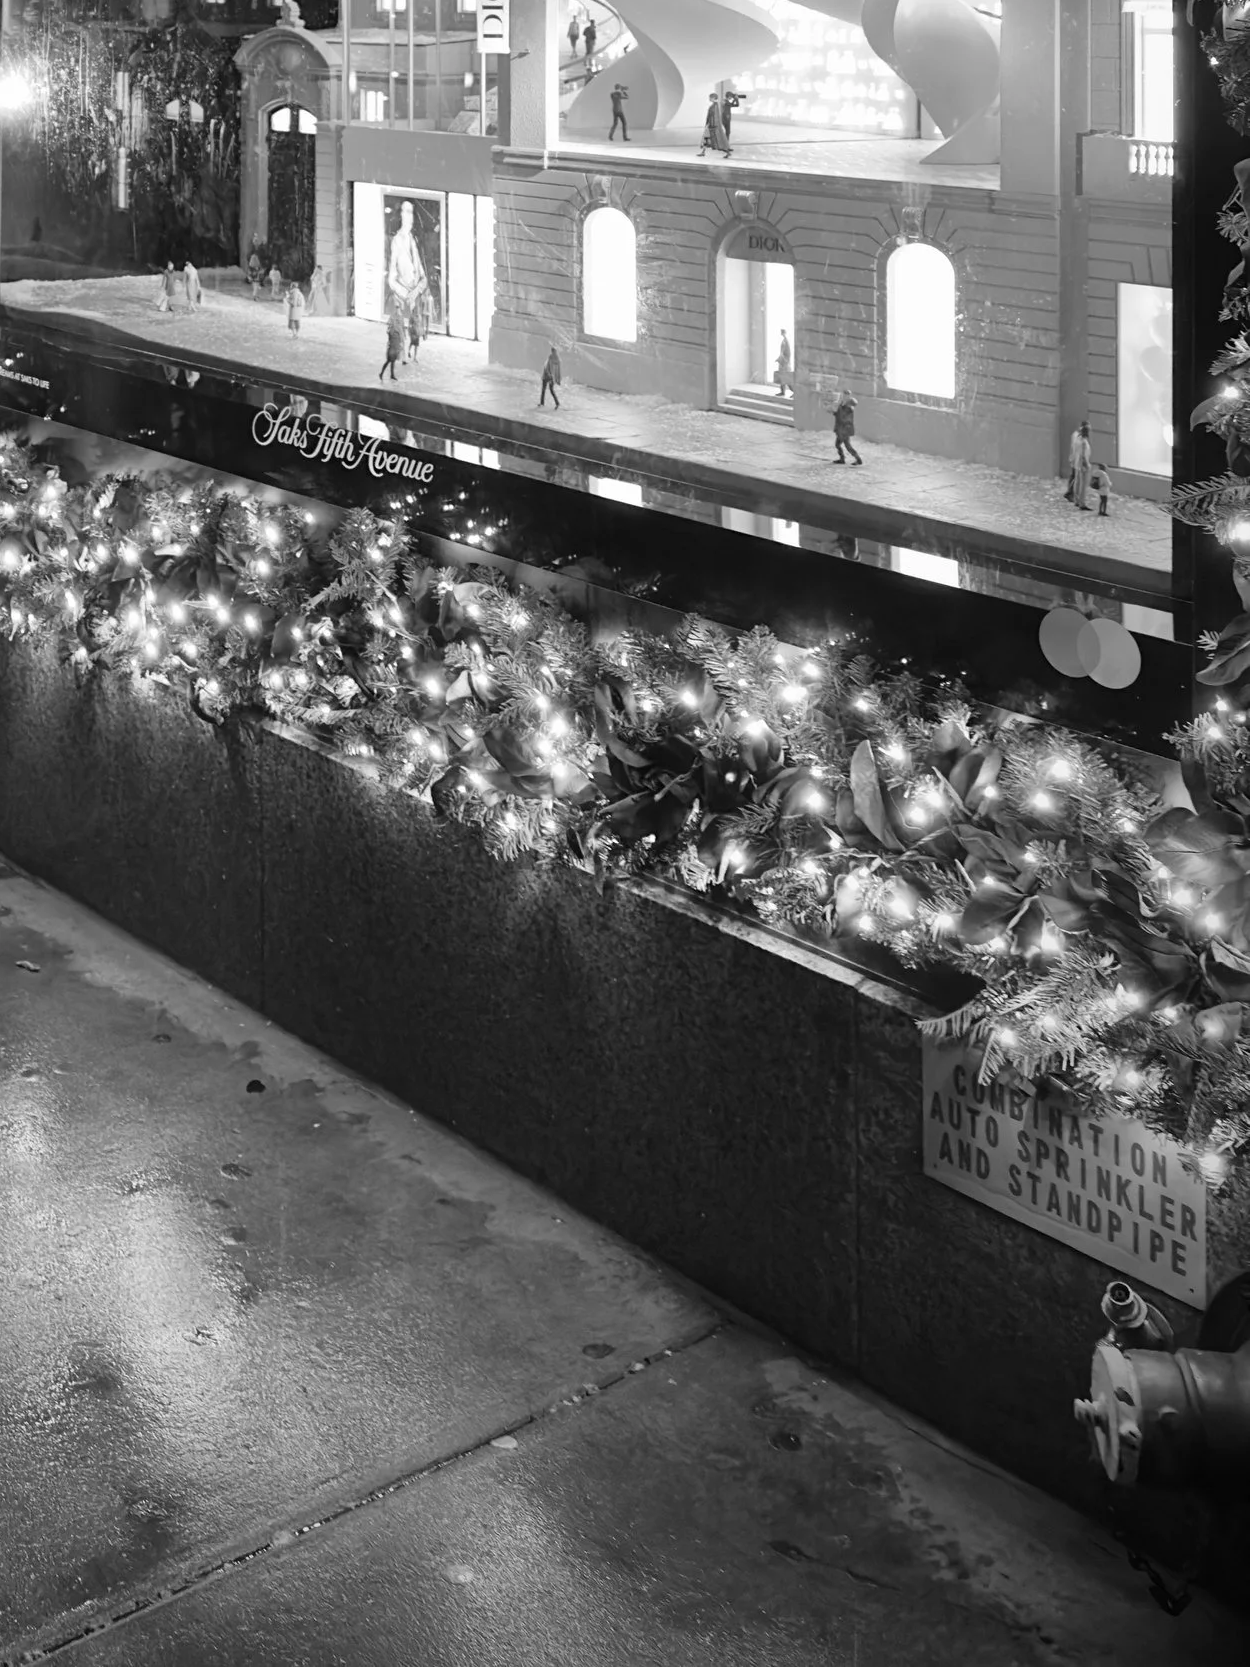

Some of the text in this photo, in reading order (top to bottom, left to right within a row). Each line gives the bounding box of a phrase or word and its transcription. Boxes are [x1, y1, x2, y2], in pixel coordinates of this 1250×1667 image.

[252, 403, 434, 483] Saks Fifth Avenue
[930, 1092, 1198, 1243] AUTO SPRINKLER
[938, 1133, 1187, 1277] AND STANDPIPE
